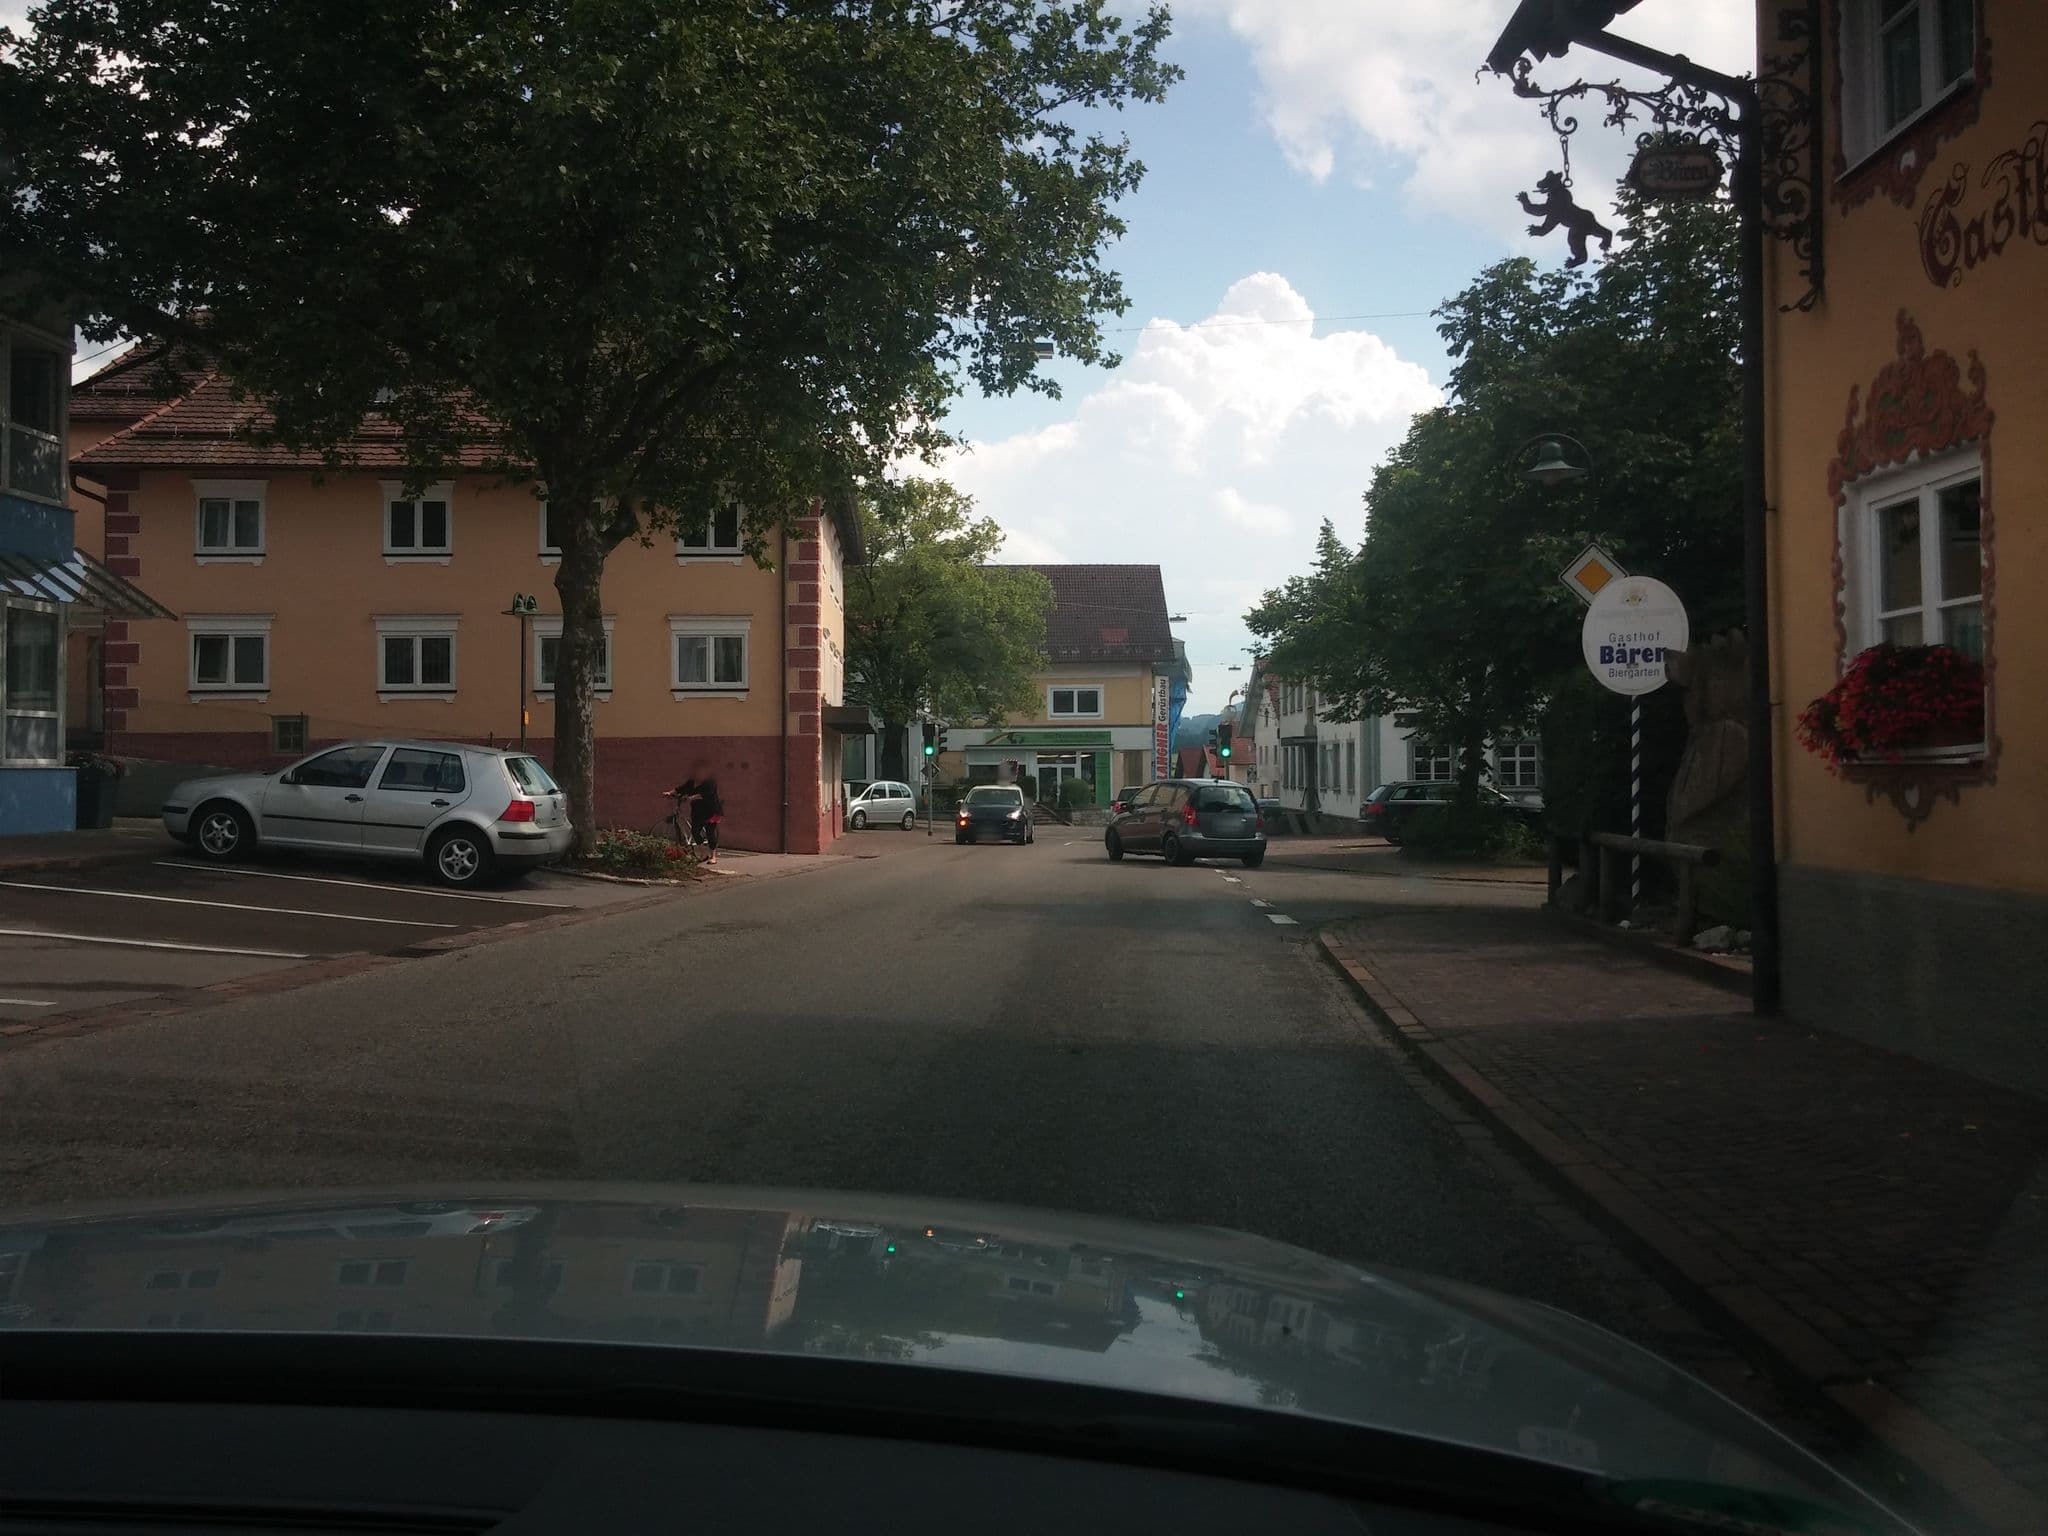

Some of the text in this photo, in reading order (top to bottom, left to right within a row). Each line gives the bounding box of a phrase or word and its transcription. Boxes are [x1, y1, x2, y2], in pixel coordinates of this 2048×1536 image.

[1608, 631, 1660, 643] Gasthof
[1608, 668, 1660, 679] Biergarten
[1156, 679, 1168, 780] LANGNER Gerüstbau
